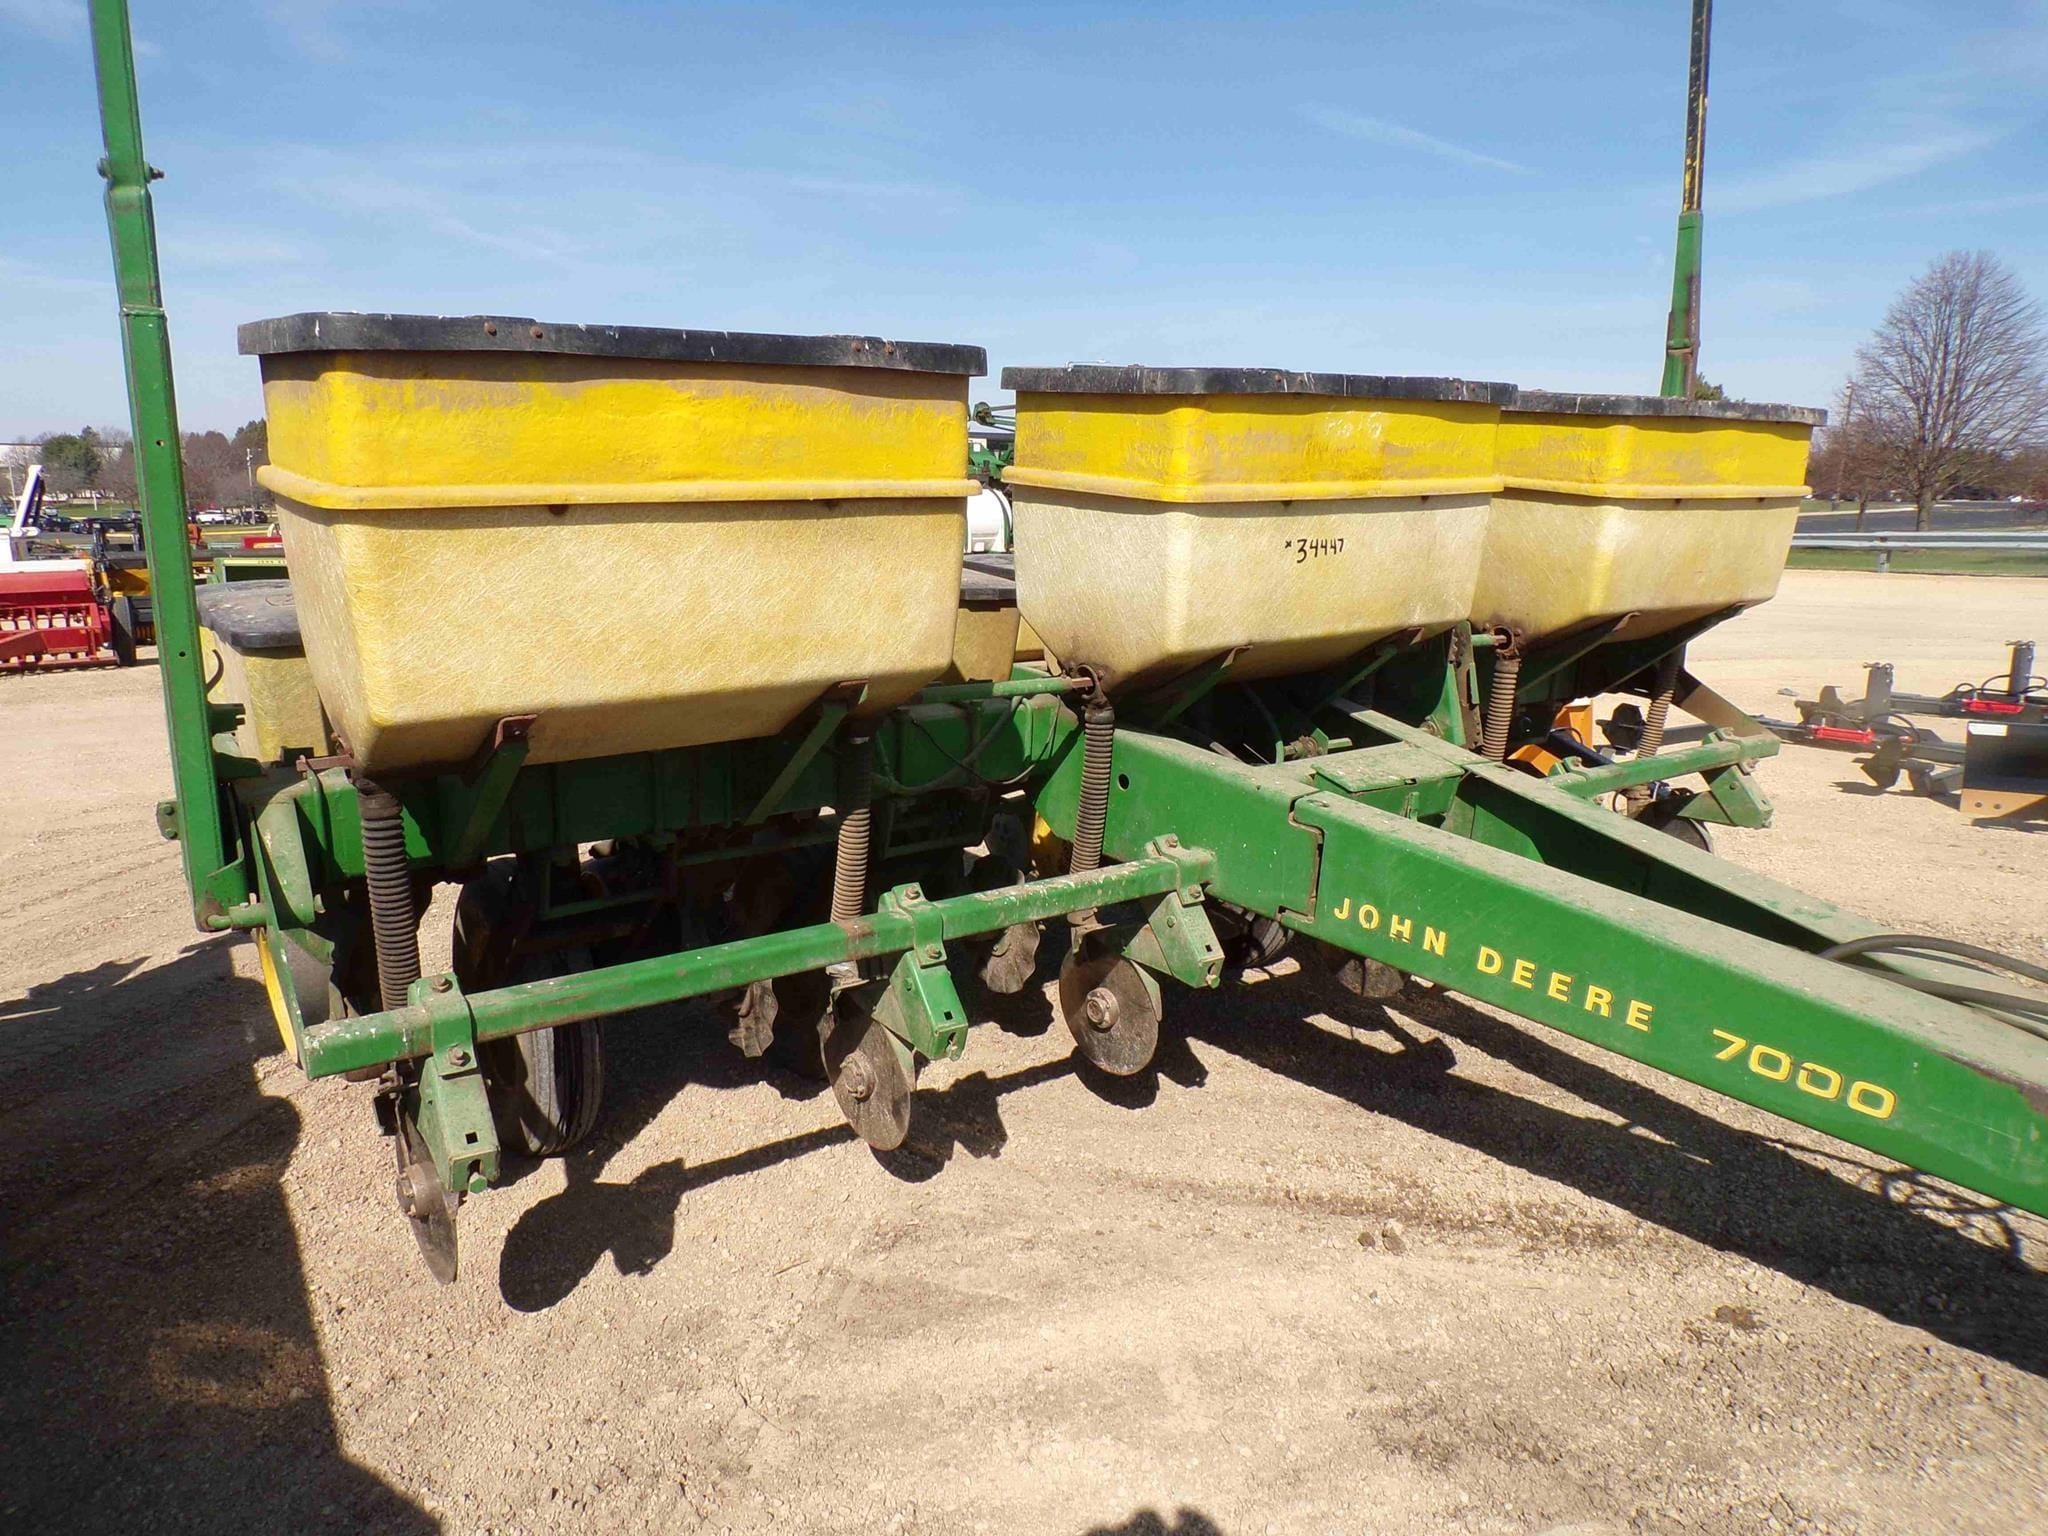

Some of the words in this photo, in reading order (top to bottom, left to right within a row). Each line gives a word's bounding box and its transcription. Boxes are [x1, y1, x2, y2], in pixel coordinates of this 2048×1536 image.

[1333, 897, 1447, 957] JOHN
[1476, 945, 1654, 1032] DEERE
[1711, 1028, 1897, 1120] 7000
